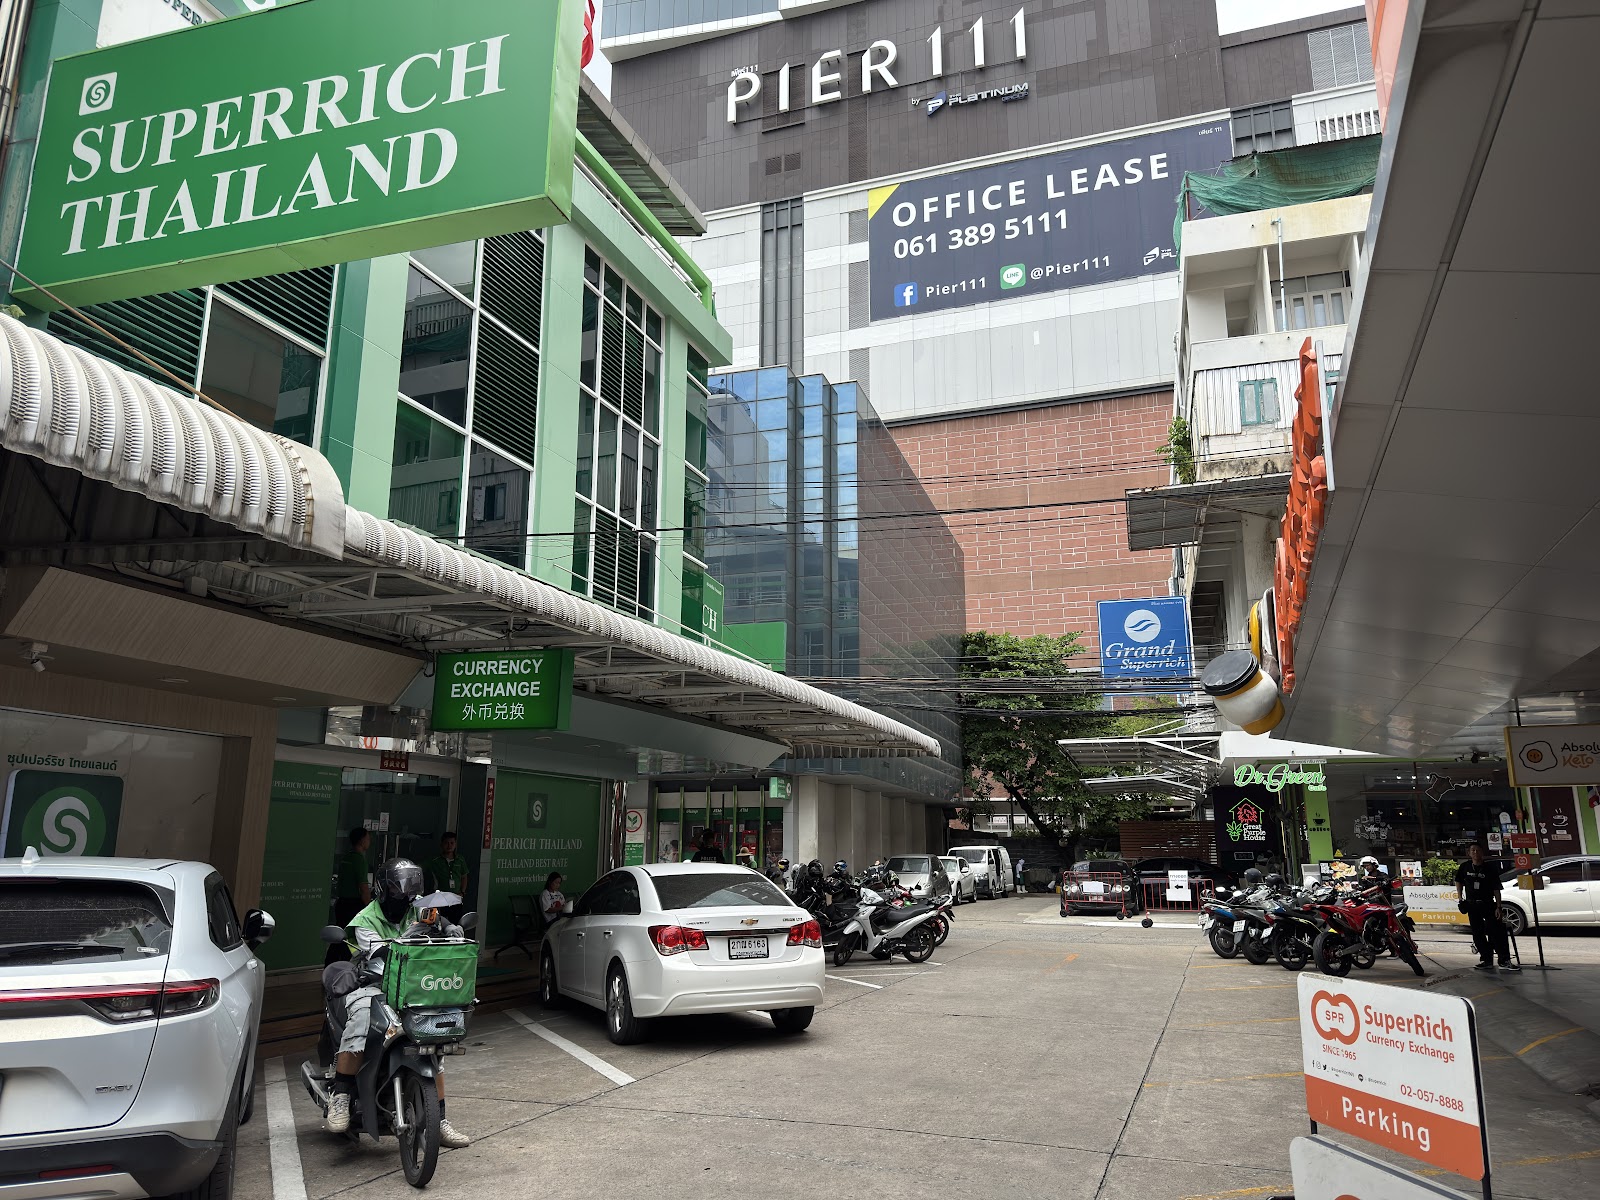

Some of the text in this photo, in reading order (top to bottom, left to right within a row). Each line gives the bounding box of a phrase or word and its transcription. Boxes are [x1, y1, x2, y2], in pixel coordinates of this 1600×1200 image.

[727, 6, 1028, 123] PIER 111
[66, 34, 510, 184] SUPERRICH
[911, 98, 921, 106] by
[61, 127, 459, 256] THAILAND
[892, 153, 1169, 229] OFFICE LEASE
[893, 209, 1069, 259] 061 389 5111
[1030, 255, 1111, 281] @Pier111
[926, 276, 987, 298] Pier111
[1105, 640, 1176, 660] Grand
[453, 659, 544, 676] CURRENCY
[451, 681, 541, 698] EXCHANGE
[462, 702, 525, 721] 外币兑换
[539, 838, 583, 850] THAILAND
[496, 857, 569, 868] THAILAND BEST RATE
[1409, 892, 1439, 900] Absolute
[1422, 913, 1457, 921] Parking
[420, 973, 464, 991] Grab
[1325, 1010, 1345, 1024] SPR
[1364, 1004, 1453, 1043] SuperRich
[1322, 1044, 1357, 1061] SINCE 1965
[1366, 1031, 1455, 1063] Currency Exchange
[1400, 1084, 1464, 1113] 02-057-8888
[1341, 1096, 1432, 1152] Parking
